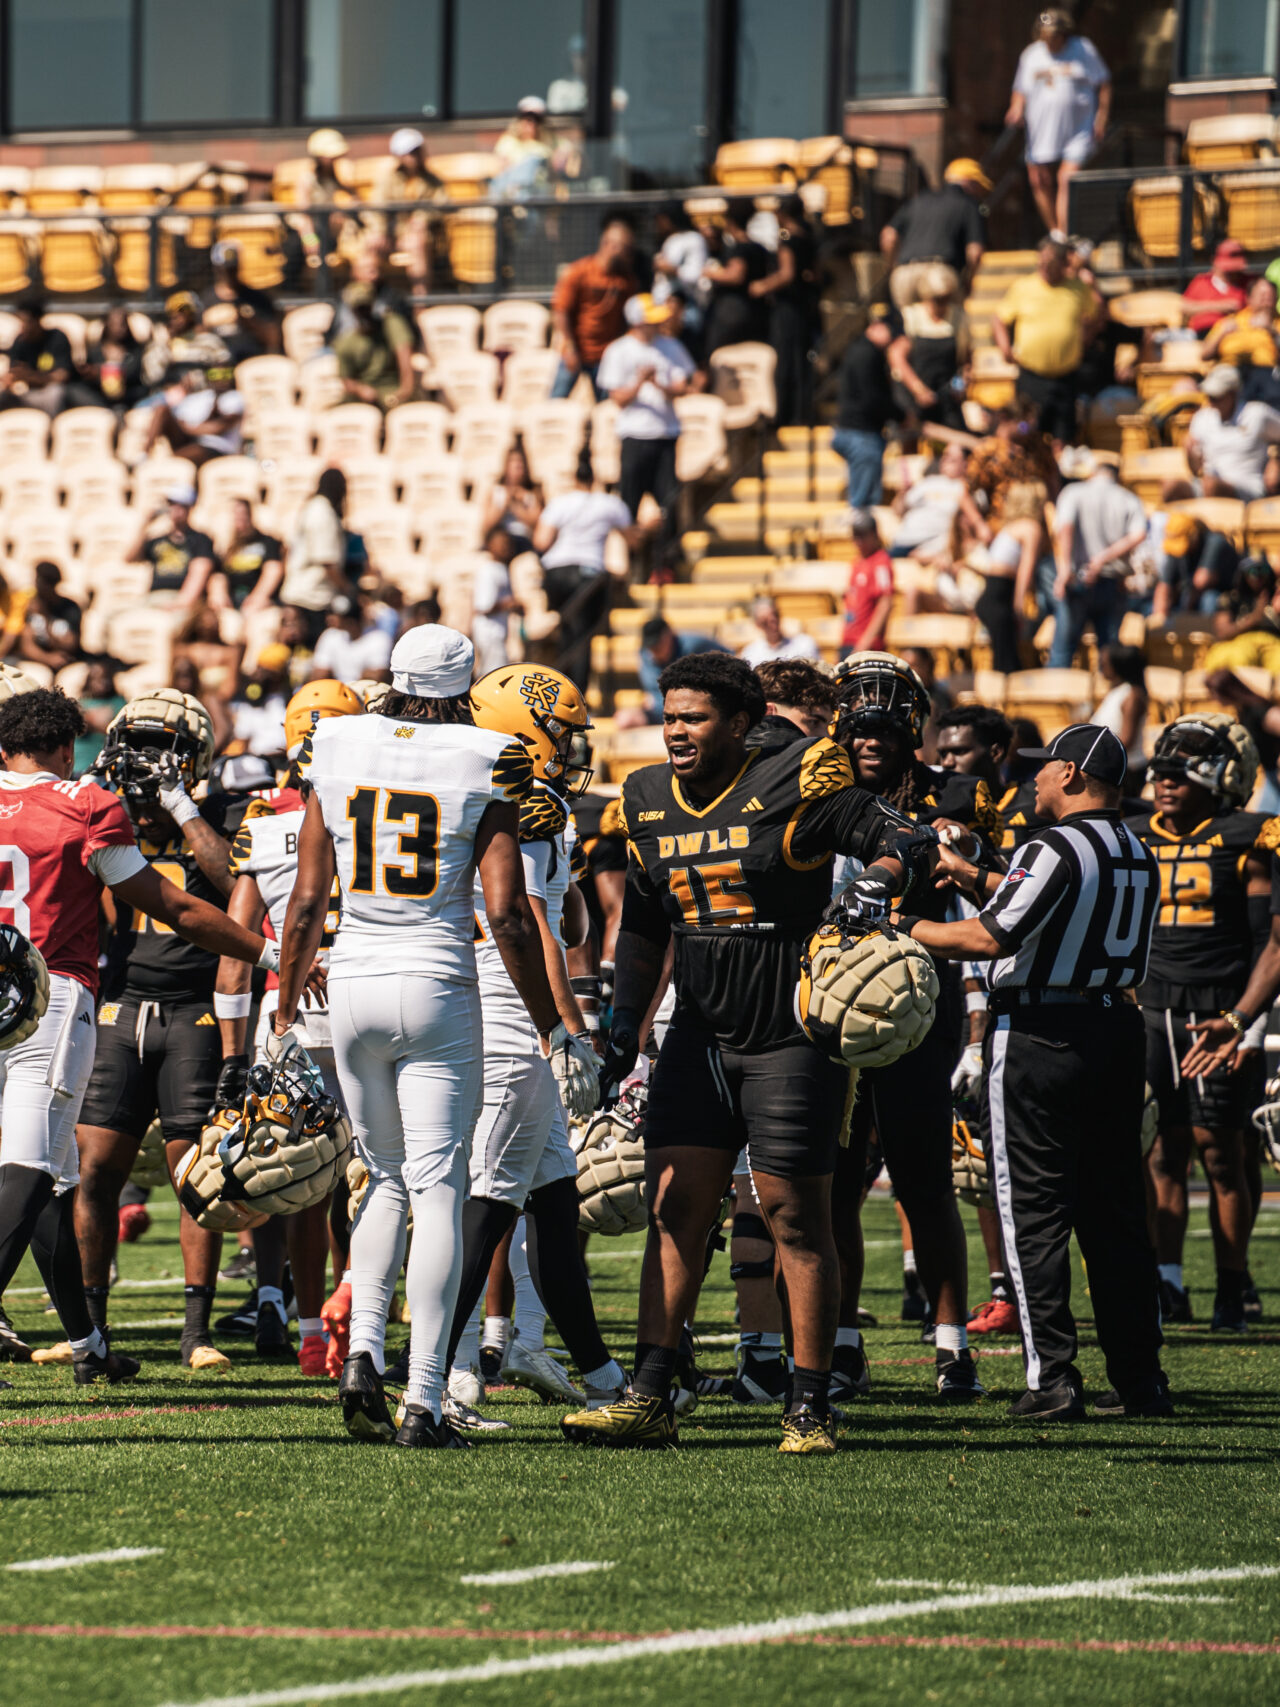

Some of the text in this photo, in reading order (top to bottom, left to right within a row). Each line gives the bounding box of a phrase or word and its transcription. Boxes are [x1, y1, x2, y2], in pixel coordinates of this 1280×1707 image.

[346, 786, 441, 898] 13
[668, 858, 757, 927] 15
[1103, 868, 1150, 958] U
[1158, 861, 1215, 927] 12
